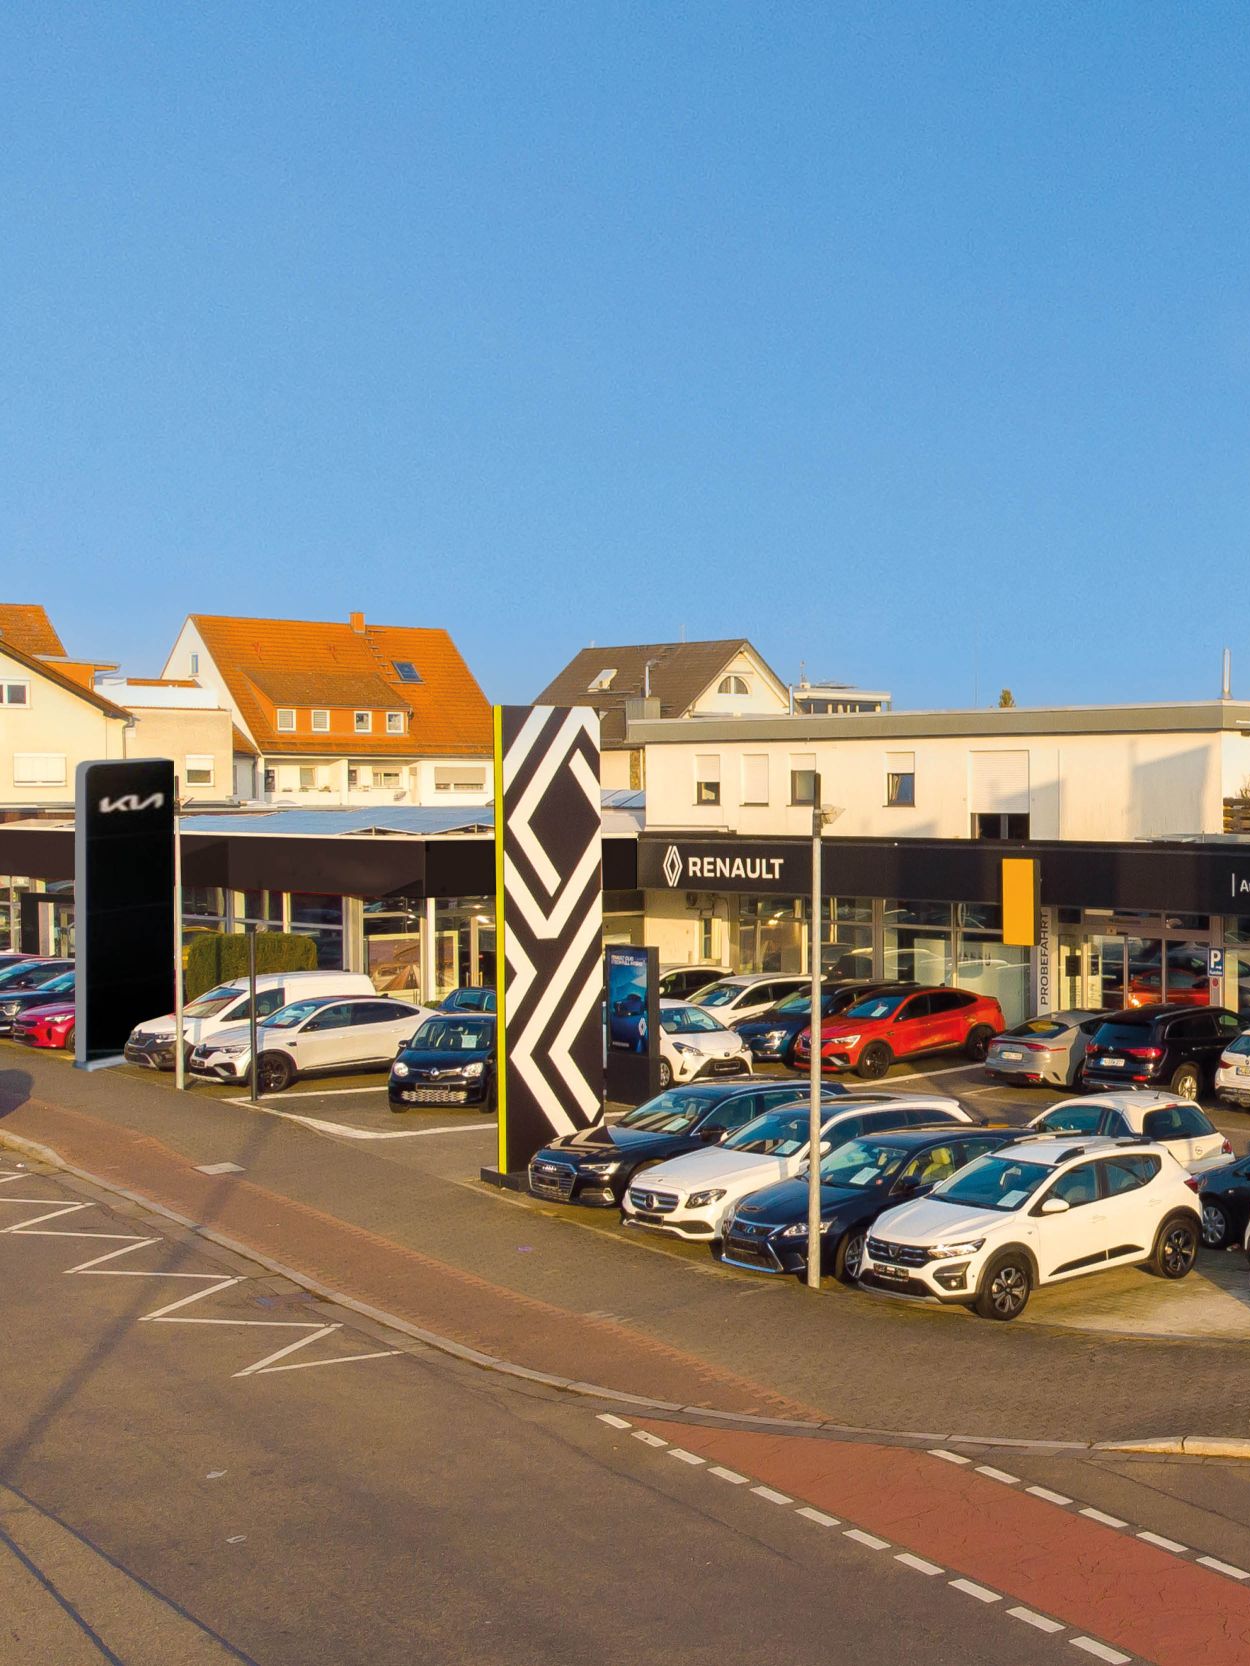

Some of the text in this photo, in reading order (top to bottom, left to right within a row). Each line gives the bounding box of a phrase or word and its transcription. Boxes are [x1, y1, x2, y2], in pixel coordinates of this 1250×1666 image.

[99, 792, 164, 813] KIA
[688, 856, 784, 879] RENAULT
[1040, 913, 1049, 1006] PROBEFAHRT
[1210, 949, 1222, 969] P
